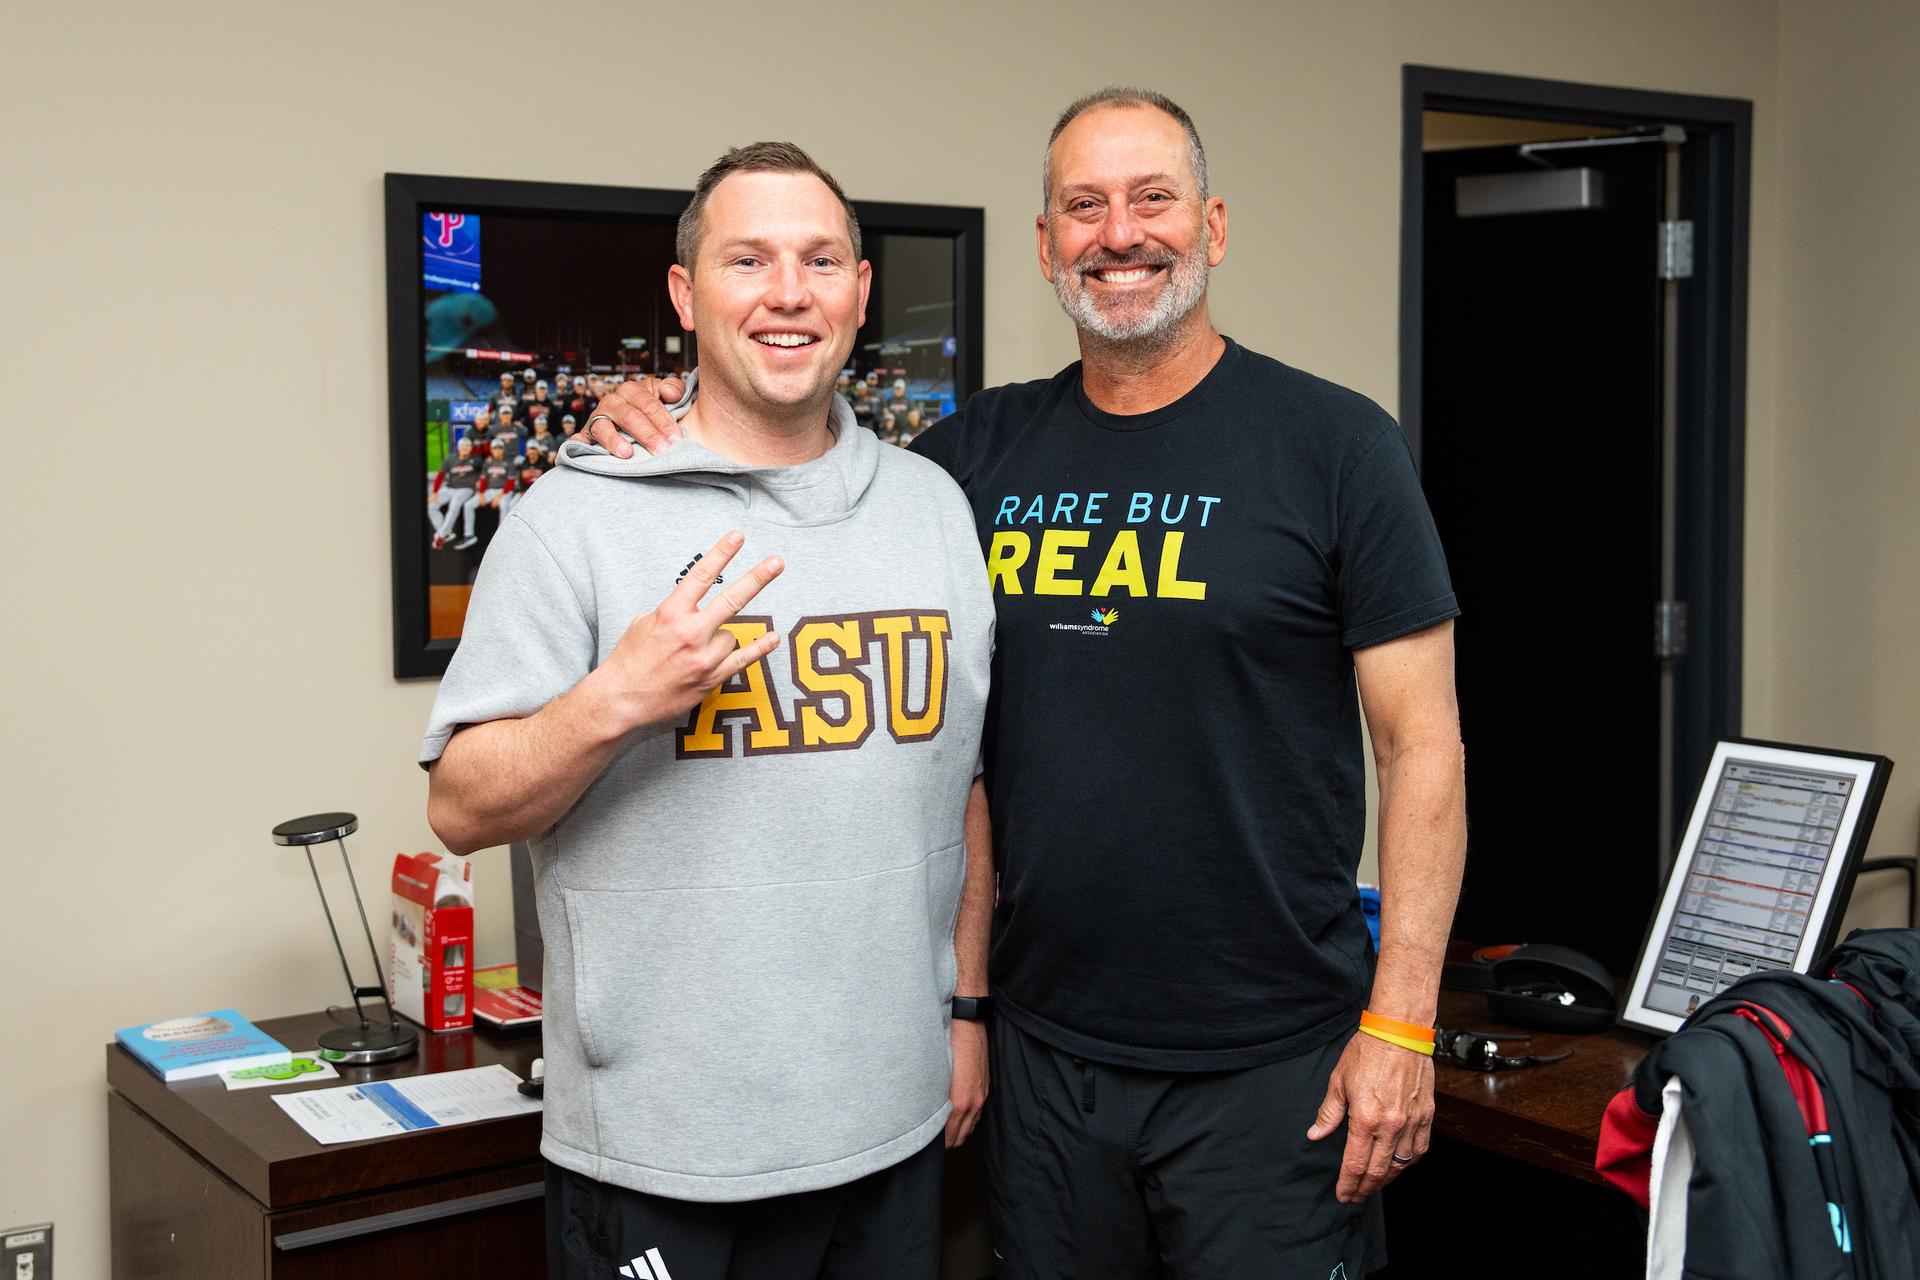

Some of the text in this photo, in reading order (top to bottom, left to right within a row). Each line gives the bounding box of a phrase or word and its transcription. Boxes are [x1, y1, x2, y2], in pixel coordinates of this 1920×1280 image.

[995, 492, 1221, 527] RARE BUT
[987, 529, 1207, 601] REAL
[676, 608, 953, 761] ASU
